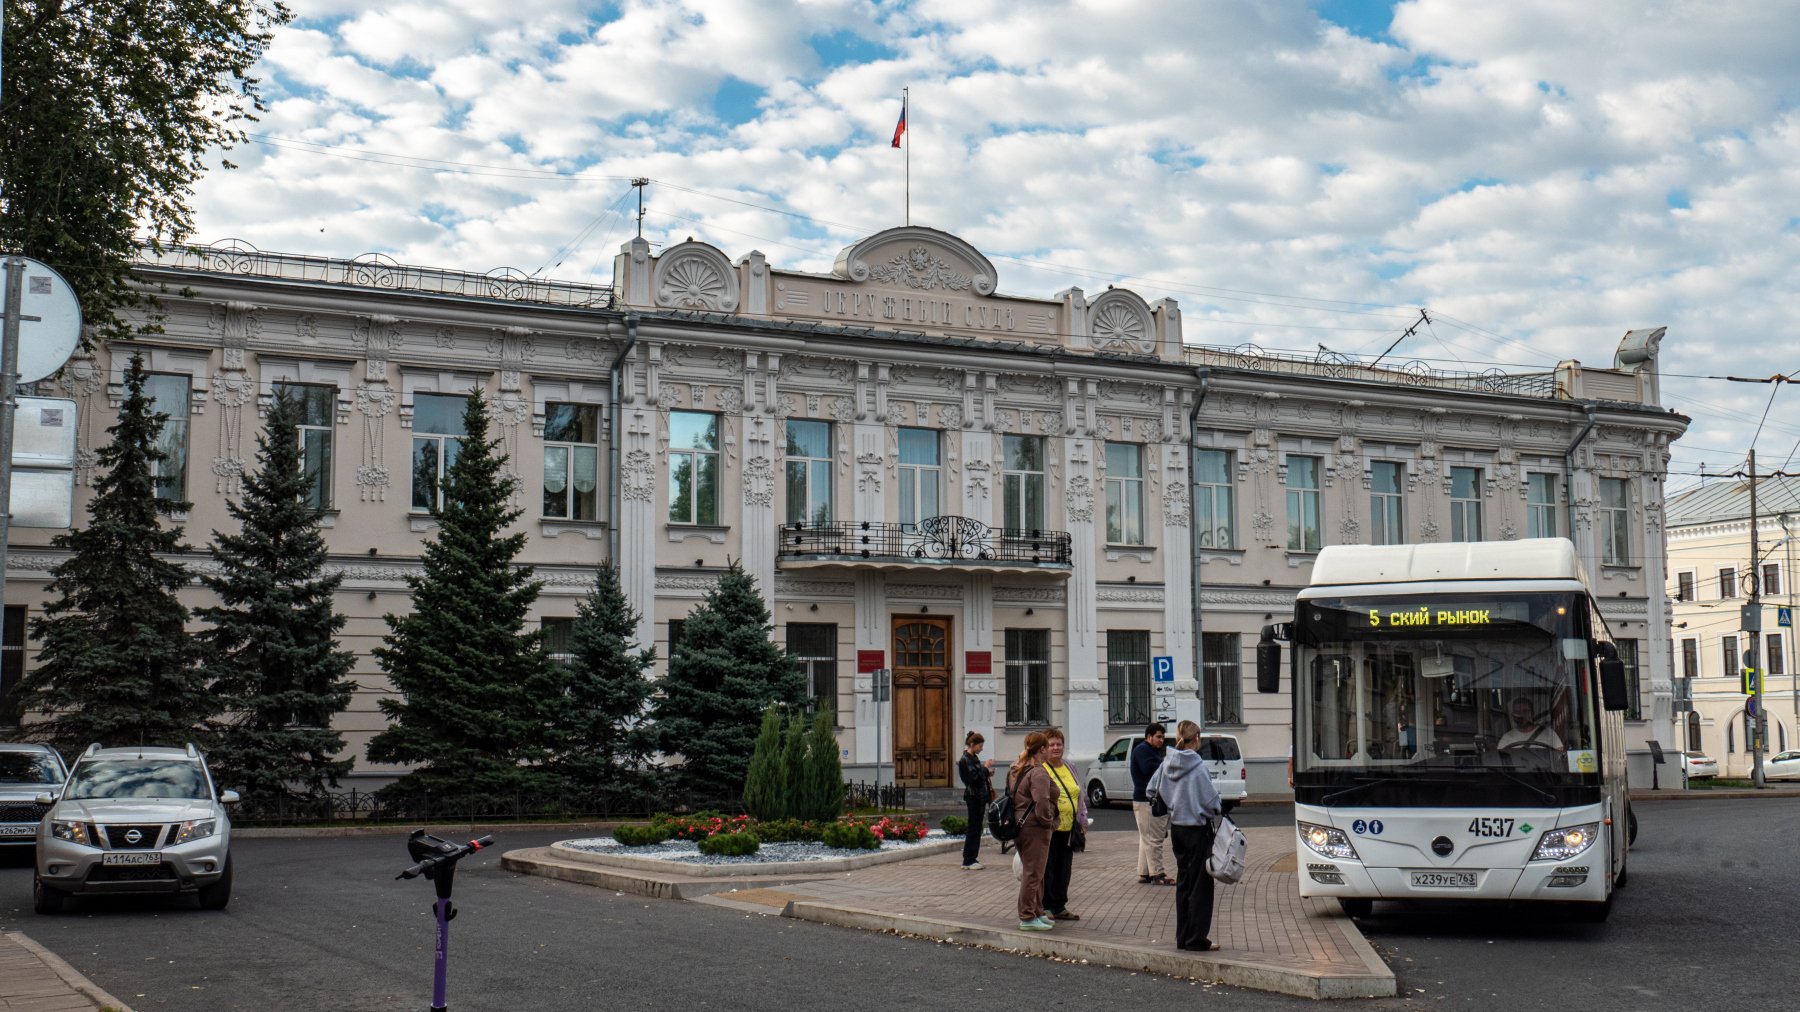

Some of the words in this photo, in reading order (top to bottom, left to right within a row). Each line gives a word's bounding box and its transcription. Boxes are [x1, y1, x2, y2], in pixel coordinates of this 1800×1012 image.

[965, 305, 1014, 330] СУДЪ
[1369, 609, 1380, 626] 5
[1390, 607, 1429, 626] СКИЙ
[1437, 610, 1490, 624] РЫНОК
[1158, 658, 1170, 680] P
[1468, 817, 1515, 837] 4537
[106, 854, 143, 864] А114АС
[144, 853, 159, 861] 763
[1415, 874, 1456, 885] Х239УЕ
[1457, 873, 1474, 883] 763
